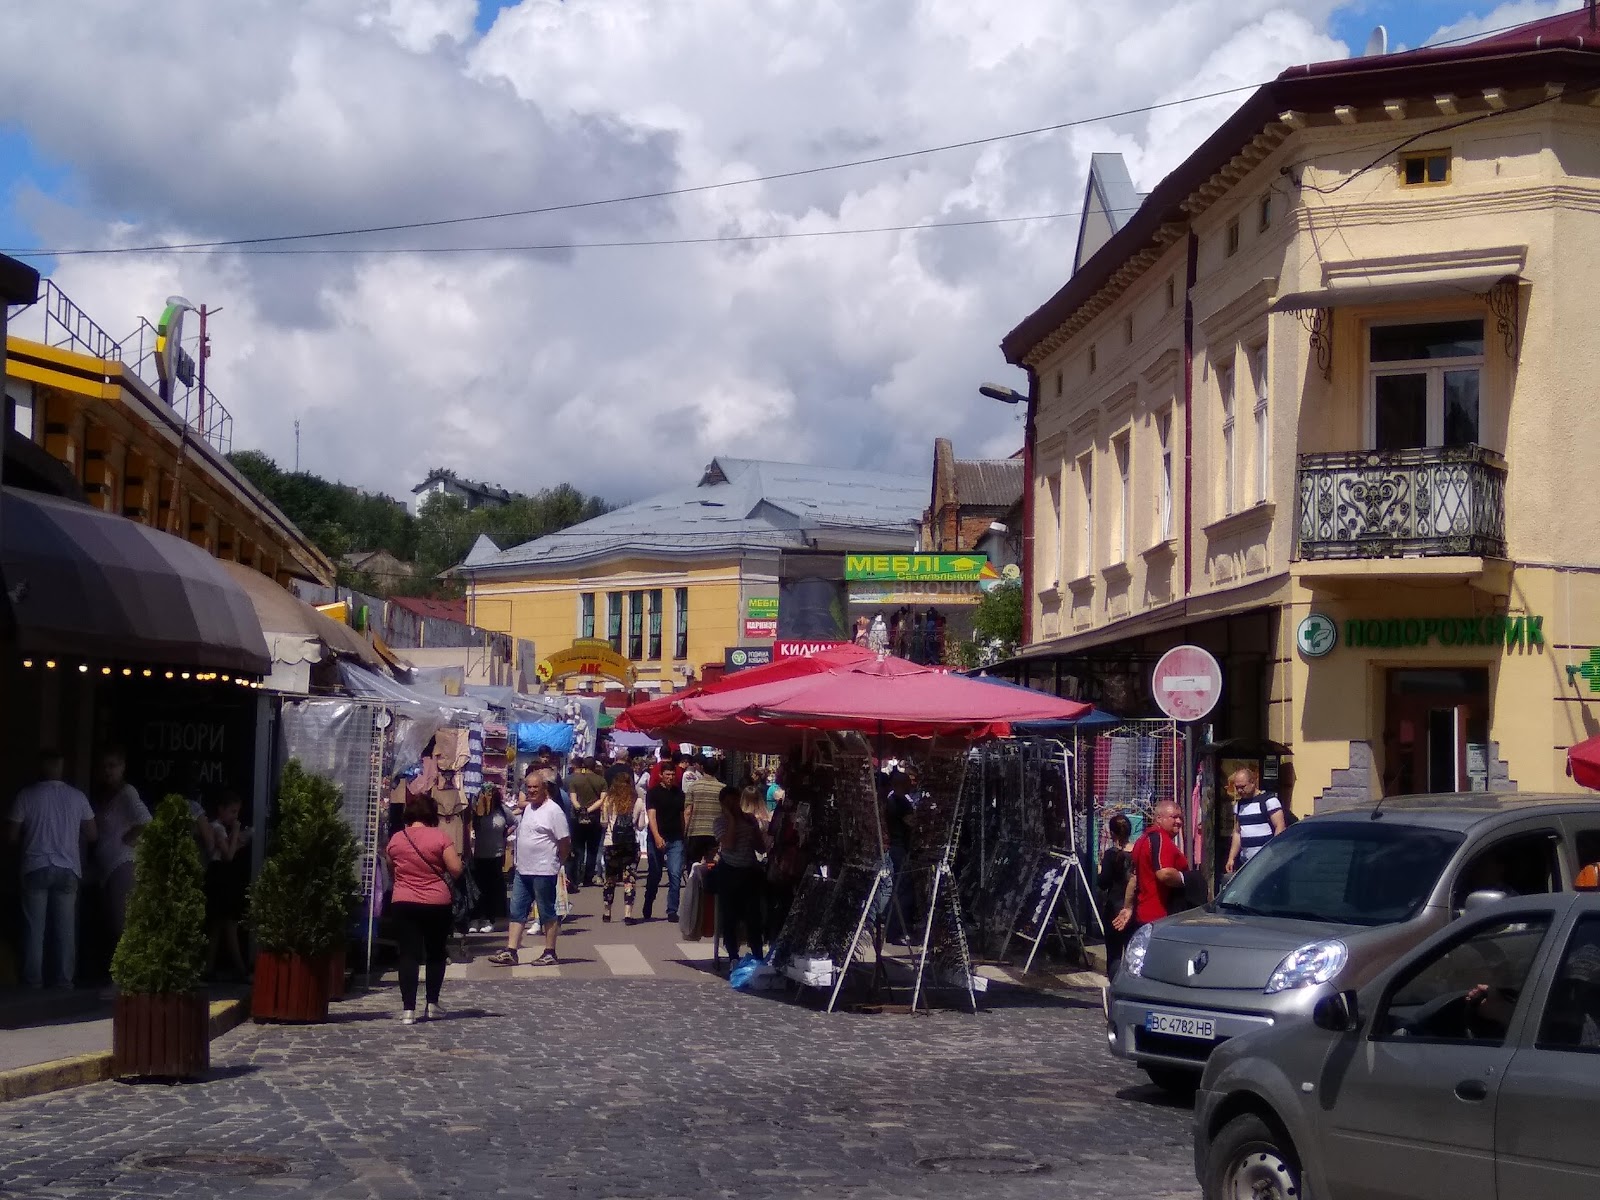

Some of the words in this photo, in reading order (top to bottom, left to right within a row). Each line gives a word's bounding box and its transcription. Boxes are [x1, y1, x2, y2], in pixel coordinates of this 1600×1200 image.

[847, 556, 940, 571] МЕБЛІ
[1344, 615, 1545, 648] ПОДОРОЖНИК
[781, 643, 841, 656] КИЛИМ
[143, 721, 225, 752] СТВОРИ
[1169, 1018, 1194, 1034] 4782
